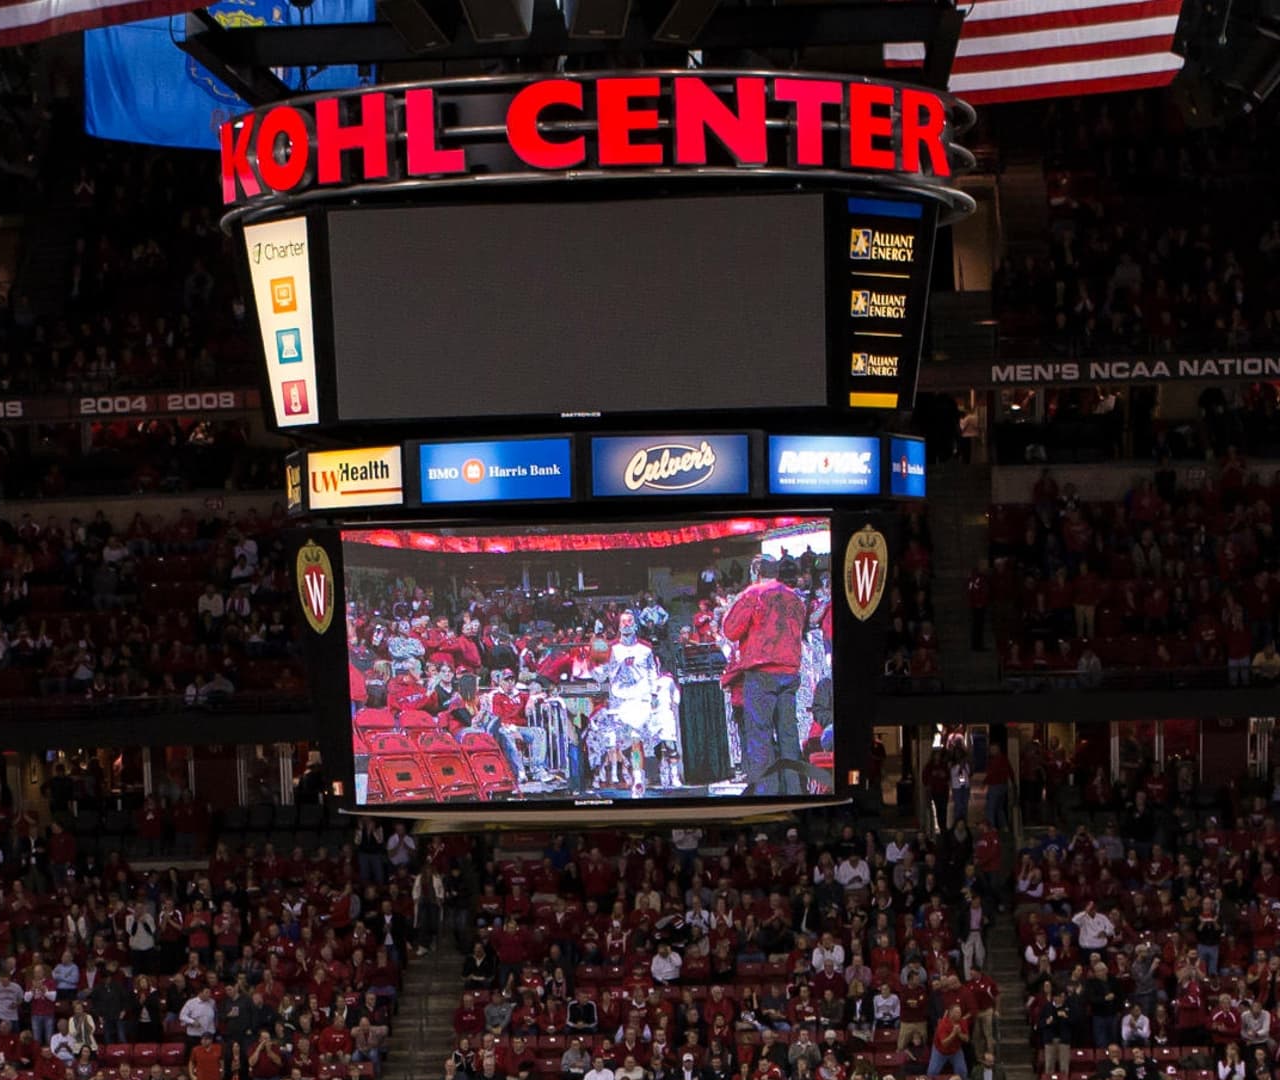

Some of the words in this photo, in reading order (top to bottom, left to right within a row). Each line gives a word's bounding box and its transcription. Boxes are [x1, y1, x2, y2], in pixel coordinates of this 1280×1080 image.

[220, 88, 467, 205] KOHL
[506, 76, 952, 178] CENTER
[264, 241, 305, 261] Charter
[872, 231, 915, 249] ALLIANT
[871, 247, 915, 262] ENERGY
[870, 292, 907, 307] ALLIANT
[869, 305, 906, 319] ENERGY
[867, 354, 899, 366] ALLIANT
[991, 361, 1080, 383] MEN'S
[1089, 359, 1171, 380] NCAA
[79, 395, 148, 415] 2004
[166, 391, 235, 412] 2008
[311, 471, 341, 493] UW
[338, 459, 390, 482] Health
[428, 468, 459, 480] BMO
[488, 465, 526, 478] Harris
[530, 464, 561, 476] Bank
[624, 441, 716, 490] Culver's
[854, 557, 879, 603] W
[305, 571, 326, 617] W
